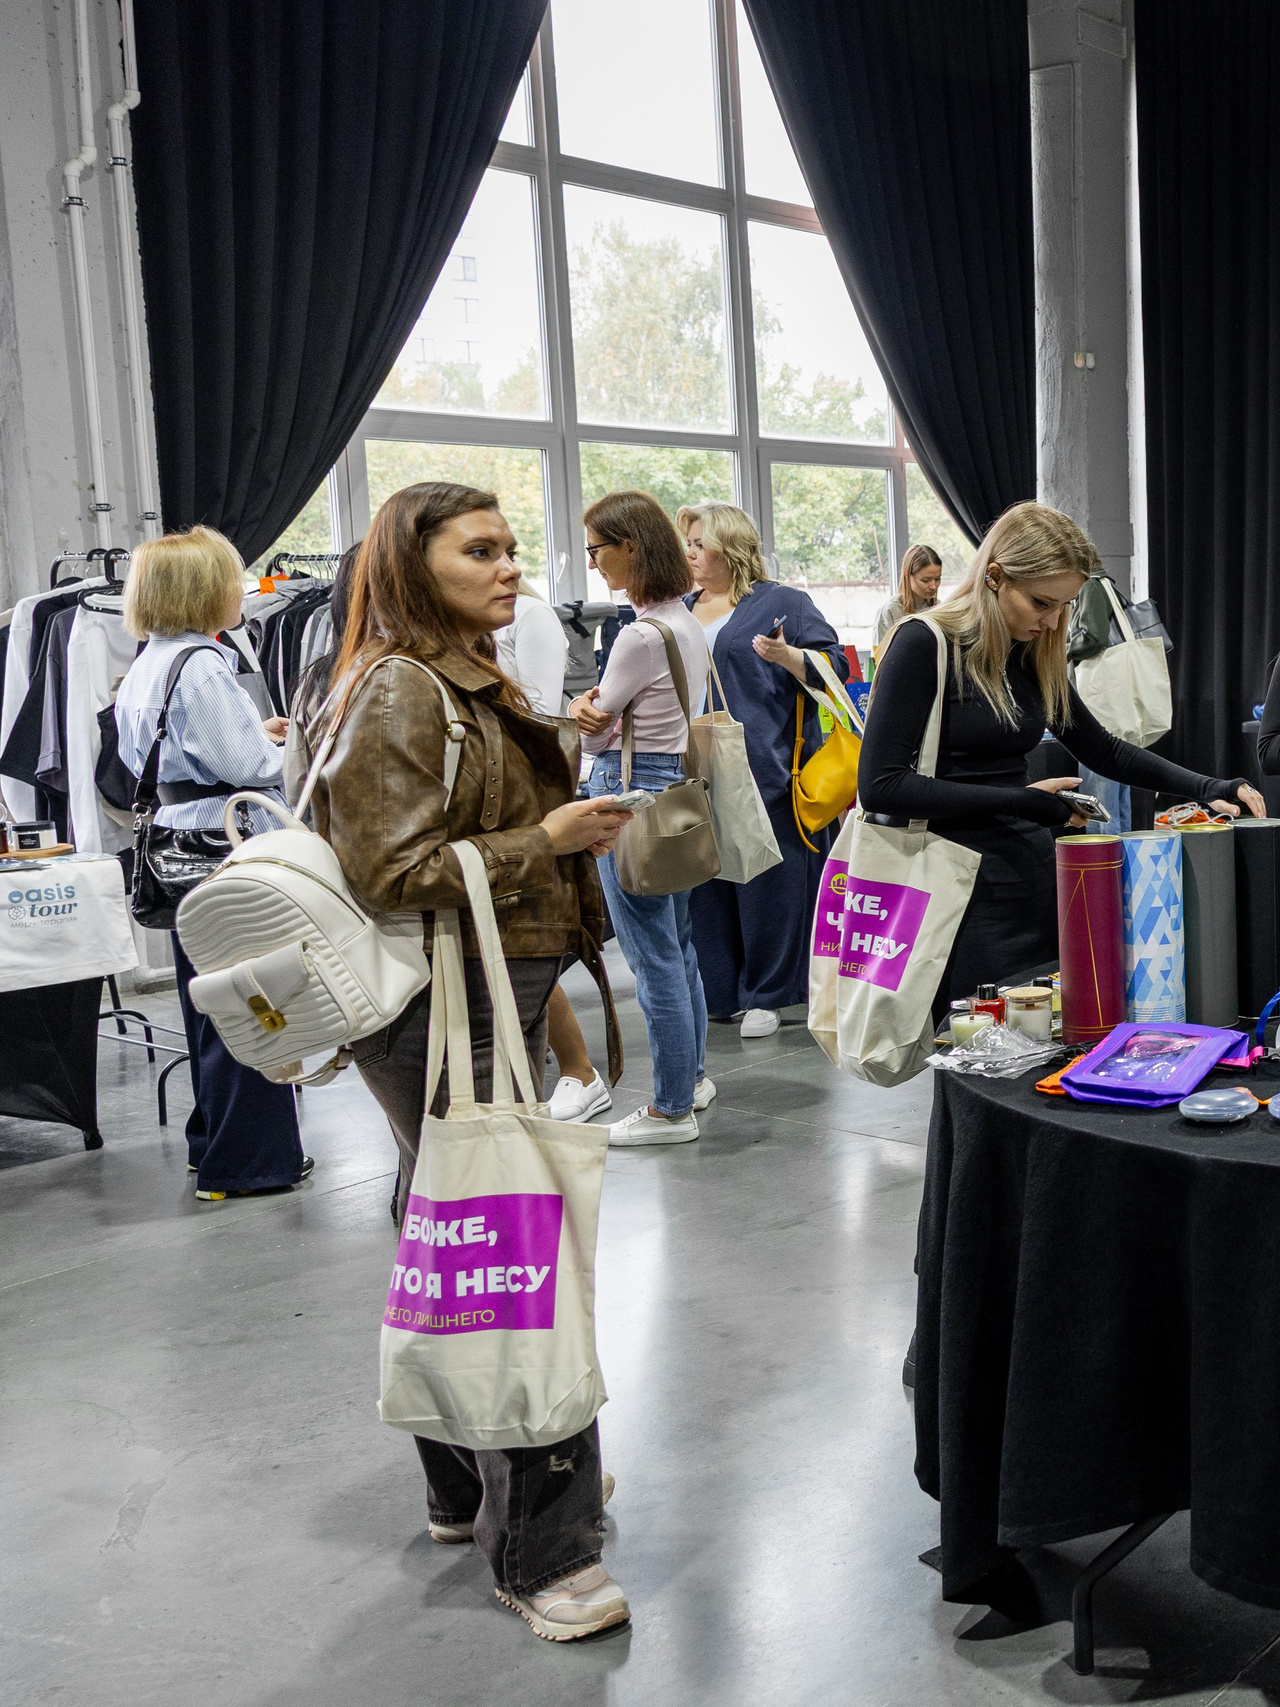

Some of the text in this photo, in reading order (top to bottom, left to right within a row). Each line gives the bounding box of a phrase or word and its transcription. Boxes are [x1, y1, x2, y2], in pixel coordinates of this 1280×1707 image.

[8, 882, 76, 904] oasis
[29, 902, 78, 918] tour
[10, 916, 78, 929] мерч-терапия
[405, 1213, 498, 1247] БОЖЕ,
[390, 1263, 423, 1295] ТО
[456, 1265, 551, 1297] НЕСУ
[413, 1309, 496, 1329] ЛИШНЕГО
